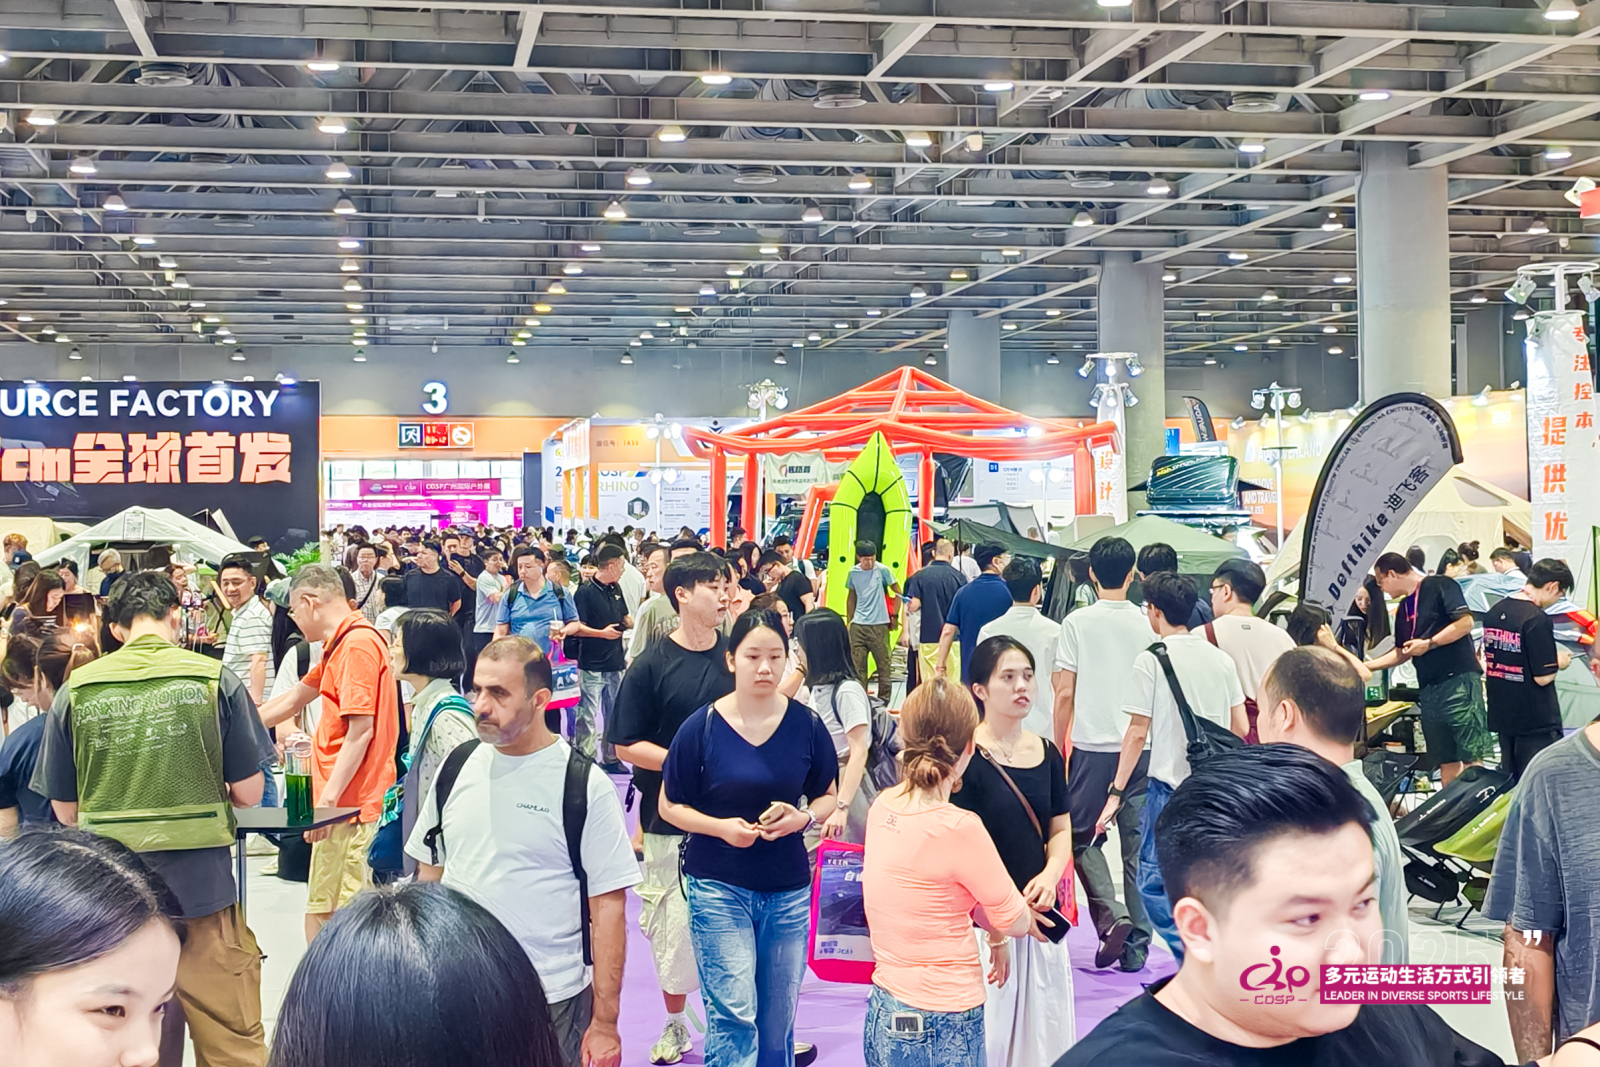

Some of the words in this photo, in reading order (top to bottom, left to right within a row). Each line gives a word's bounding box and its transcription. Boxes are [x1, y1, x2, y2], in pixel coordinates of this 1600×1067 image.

[109, 389, 280, 417] FACTORY
[422, 381, 448, 415] 3
[1327, 511, 1389, 601] Defthike
[1383, 465, 1430, 513] 迪飞客
